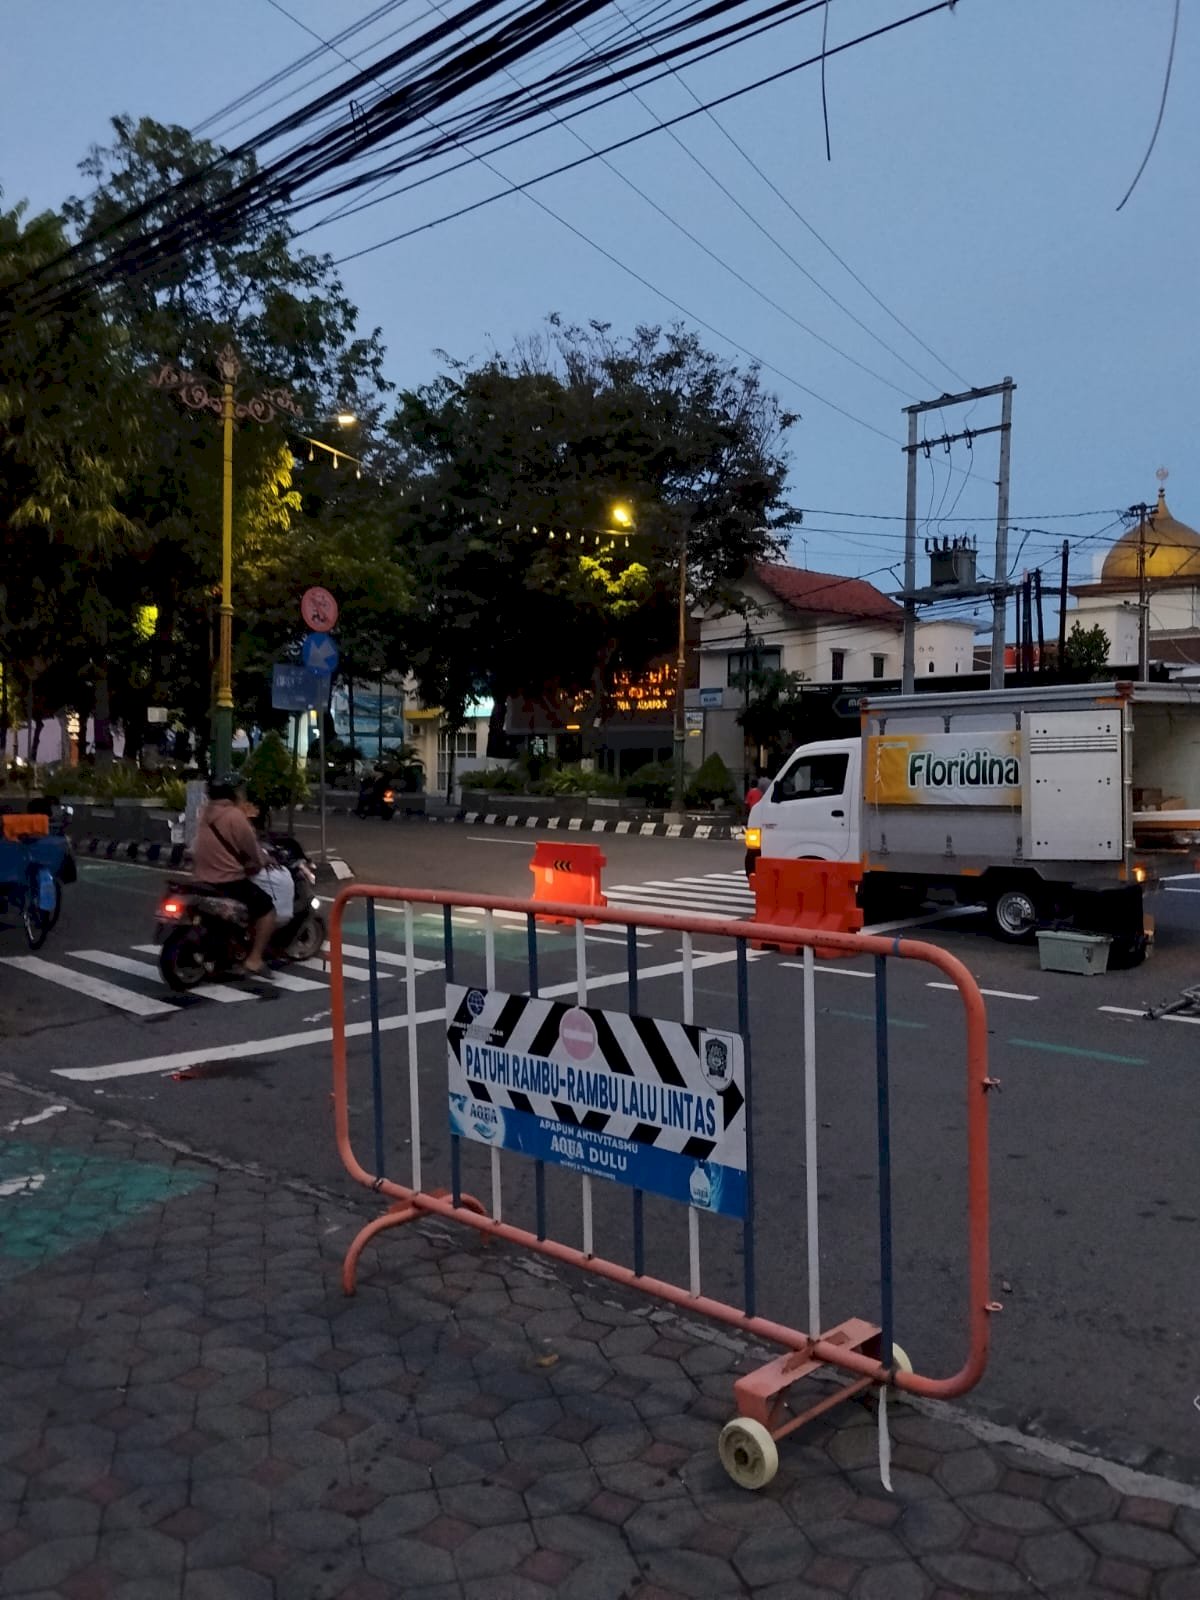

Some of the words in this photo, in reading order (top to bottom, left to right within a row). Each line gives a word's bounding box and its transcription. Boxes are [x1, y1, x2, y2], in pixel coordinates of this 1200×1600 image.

[909, 752, 1019, 786] Floridina
[465, 1044, 510, 1086] PATUHI
[513, 1062, 618, 1113] RAMBU-RAMBU
[621, 1080, 658, 1122] LALU
[660, 1088, 716, 1137] LINTAS
[470, 1103, 499, 1124] AQUA
[539, 1119, 575, 1136] APAPUN
[576, 1129, 639, 1154] AKTIVITASMU
[550, 1134, 585, 1160] AQUA
[589, 1147, 628, 1172] DULU
